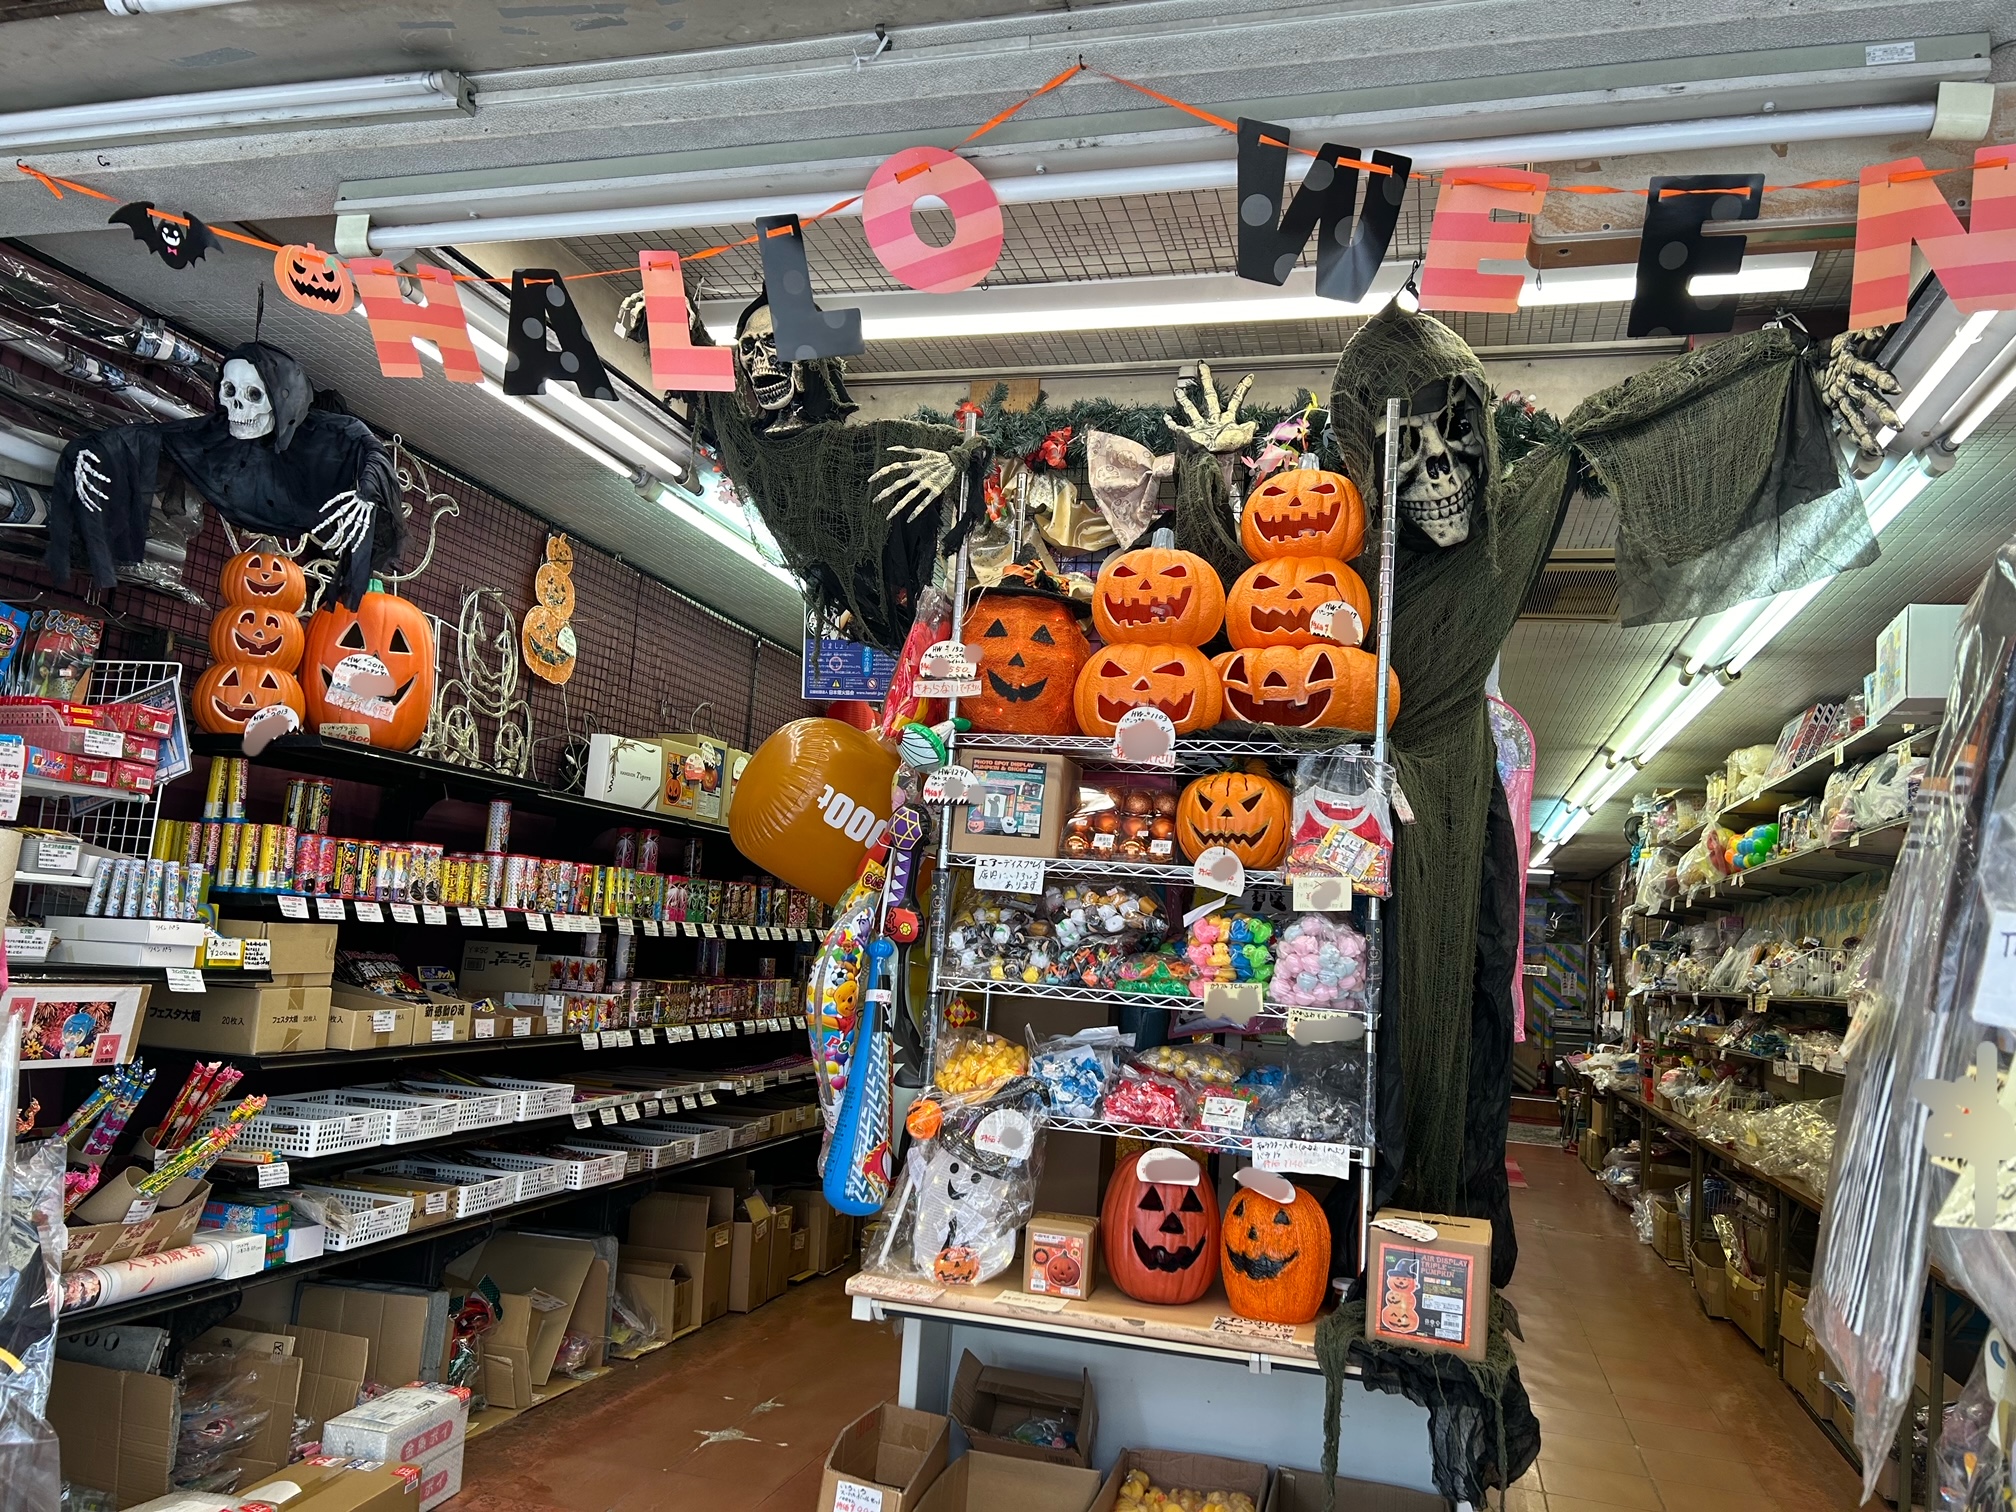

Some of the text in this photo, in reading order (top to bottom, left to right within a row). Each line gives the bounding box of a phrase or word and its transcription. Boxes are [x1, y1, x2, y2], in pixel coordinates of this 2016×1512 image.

[636, 771, 651, 781] Tigers
[221, 1015, 245, 1026] 20枚入
[1421, 1254, 1468, 1267] AIR DISPLAY
[1421, 1261, 1447, 1271] TRIPLE
[1420, 1268, 1455, 1278] PUMPKIN
